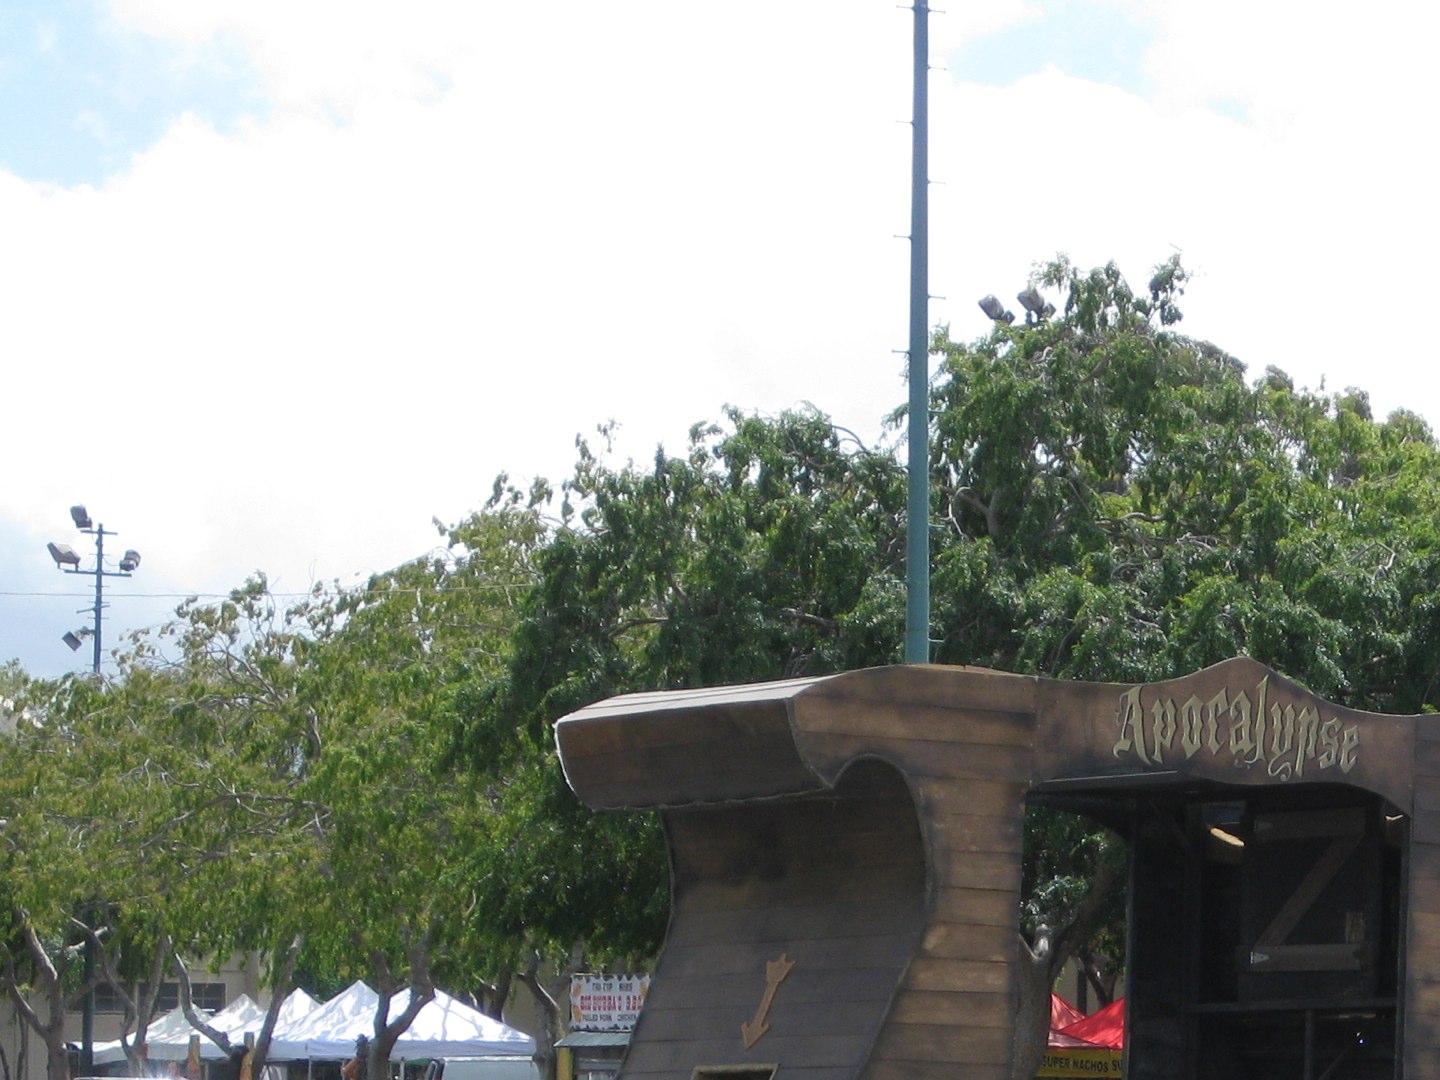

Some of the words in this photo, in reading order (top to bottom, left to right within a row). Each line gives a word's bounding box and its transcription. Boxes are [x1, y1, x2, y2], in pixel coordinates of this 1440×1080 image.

[1113, 674, 1360, 782] Apocalypse
[1042, 1055, 1070, 1069] SUPER
[1073, 1058, 1109, 1073] NACHOS
